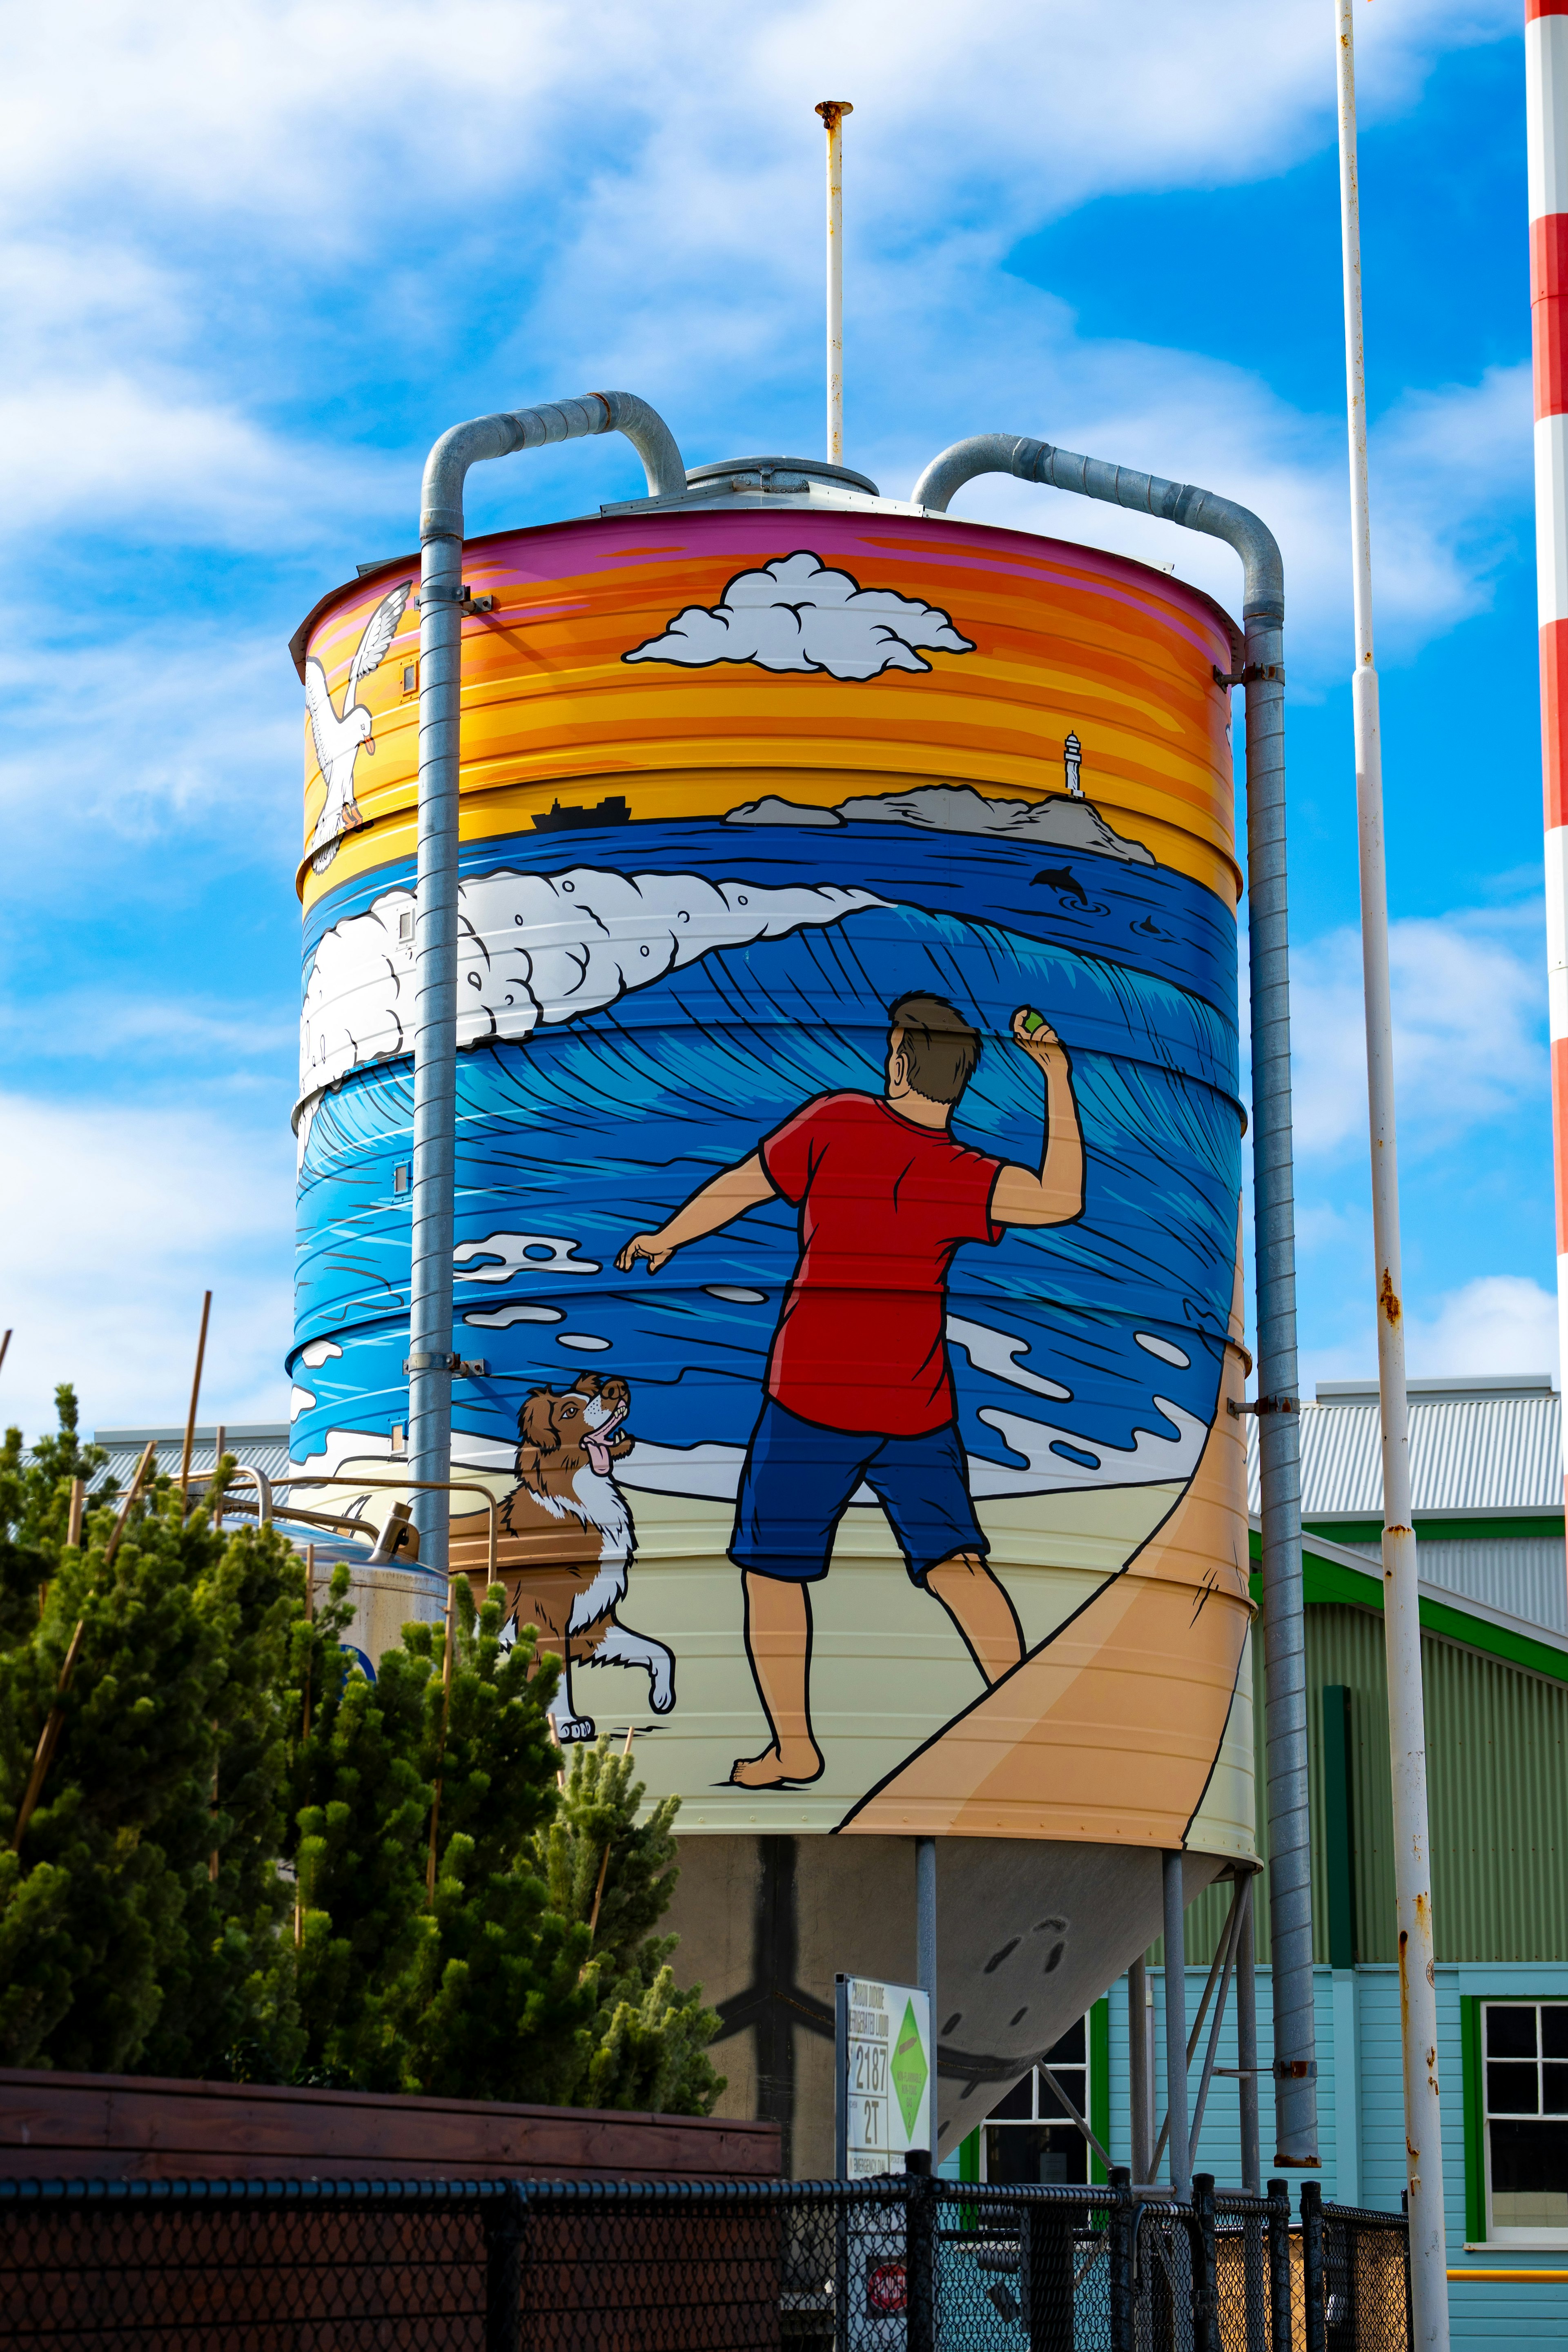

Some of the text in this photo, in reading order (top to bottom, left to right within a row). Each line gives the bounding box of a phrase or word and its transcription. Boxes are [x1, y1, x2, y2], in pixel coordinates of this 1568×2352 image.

[852, 1982, 884, 2010] CARBON DIOXIDE
[876, 2013, 888, 2038] LIQUID
[856, 2045, 886, 2091] 2187
[864, 2100, 879, 2144] 2T
[908, 2112, 911, 2128] 2
[849, 2158, 853, 2172] IN
[854, 2158, 876, 2173] EMERGENCY
[877, 2159, 885, 2173] DIAL
